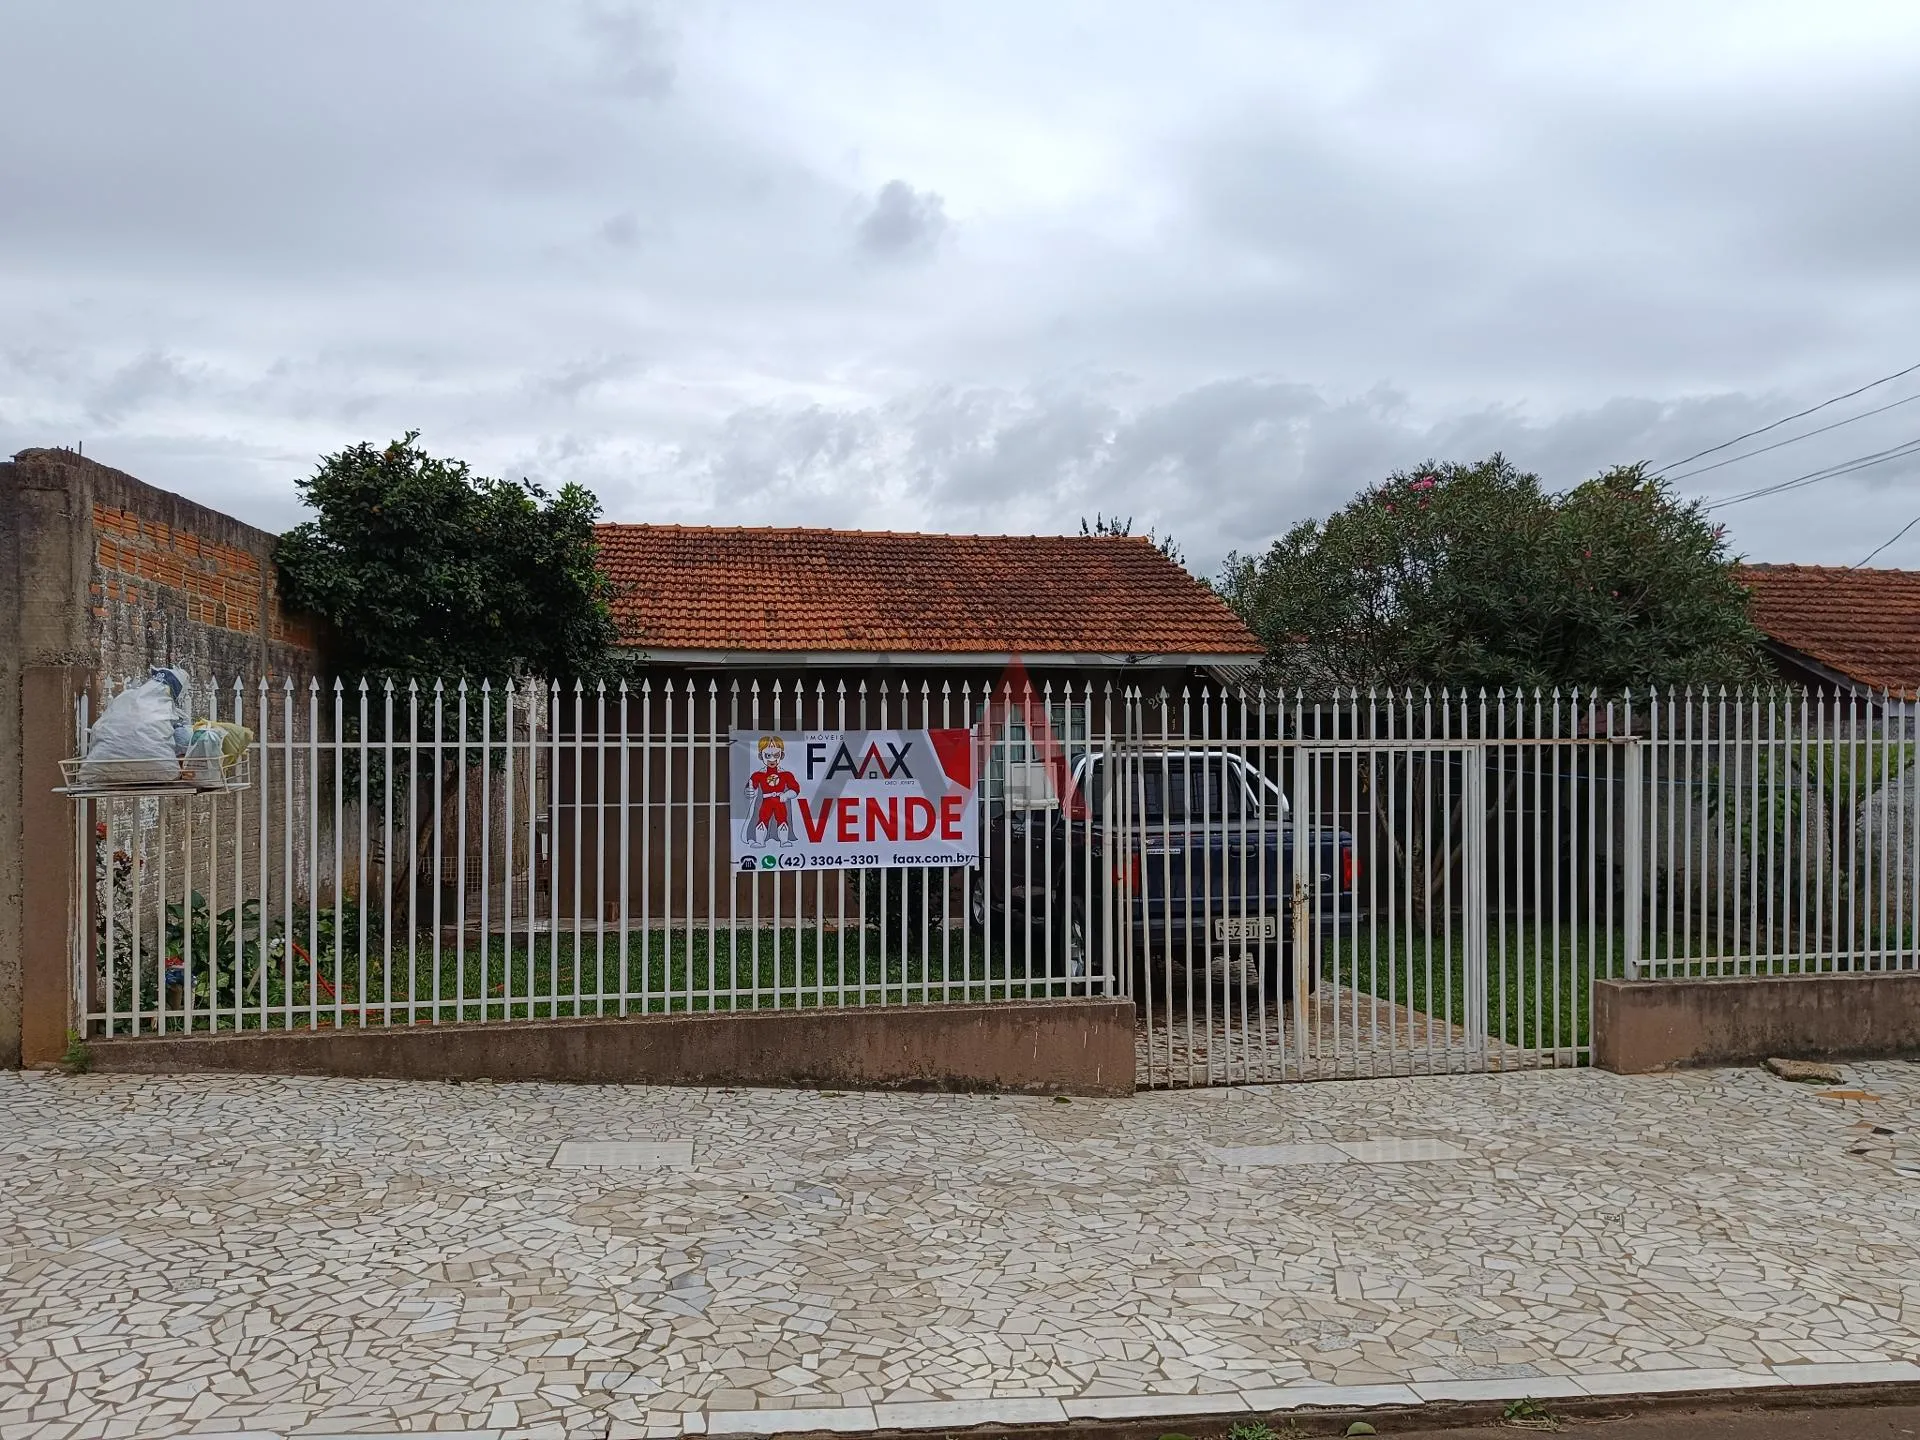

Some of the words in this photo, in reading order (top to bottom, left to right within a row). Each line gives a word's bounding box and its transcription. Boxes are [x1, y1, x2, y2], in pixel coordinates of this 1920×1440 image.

[806, 741, 914, 780] FAAX
[797, 796, 963, 843] VENDE
[778, 853, 806, 868] (42)
[810, 855, 879, 866] 3304-3301
[893, 853, 970, 865] faax.com.br
